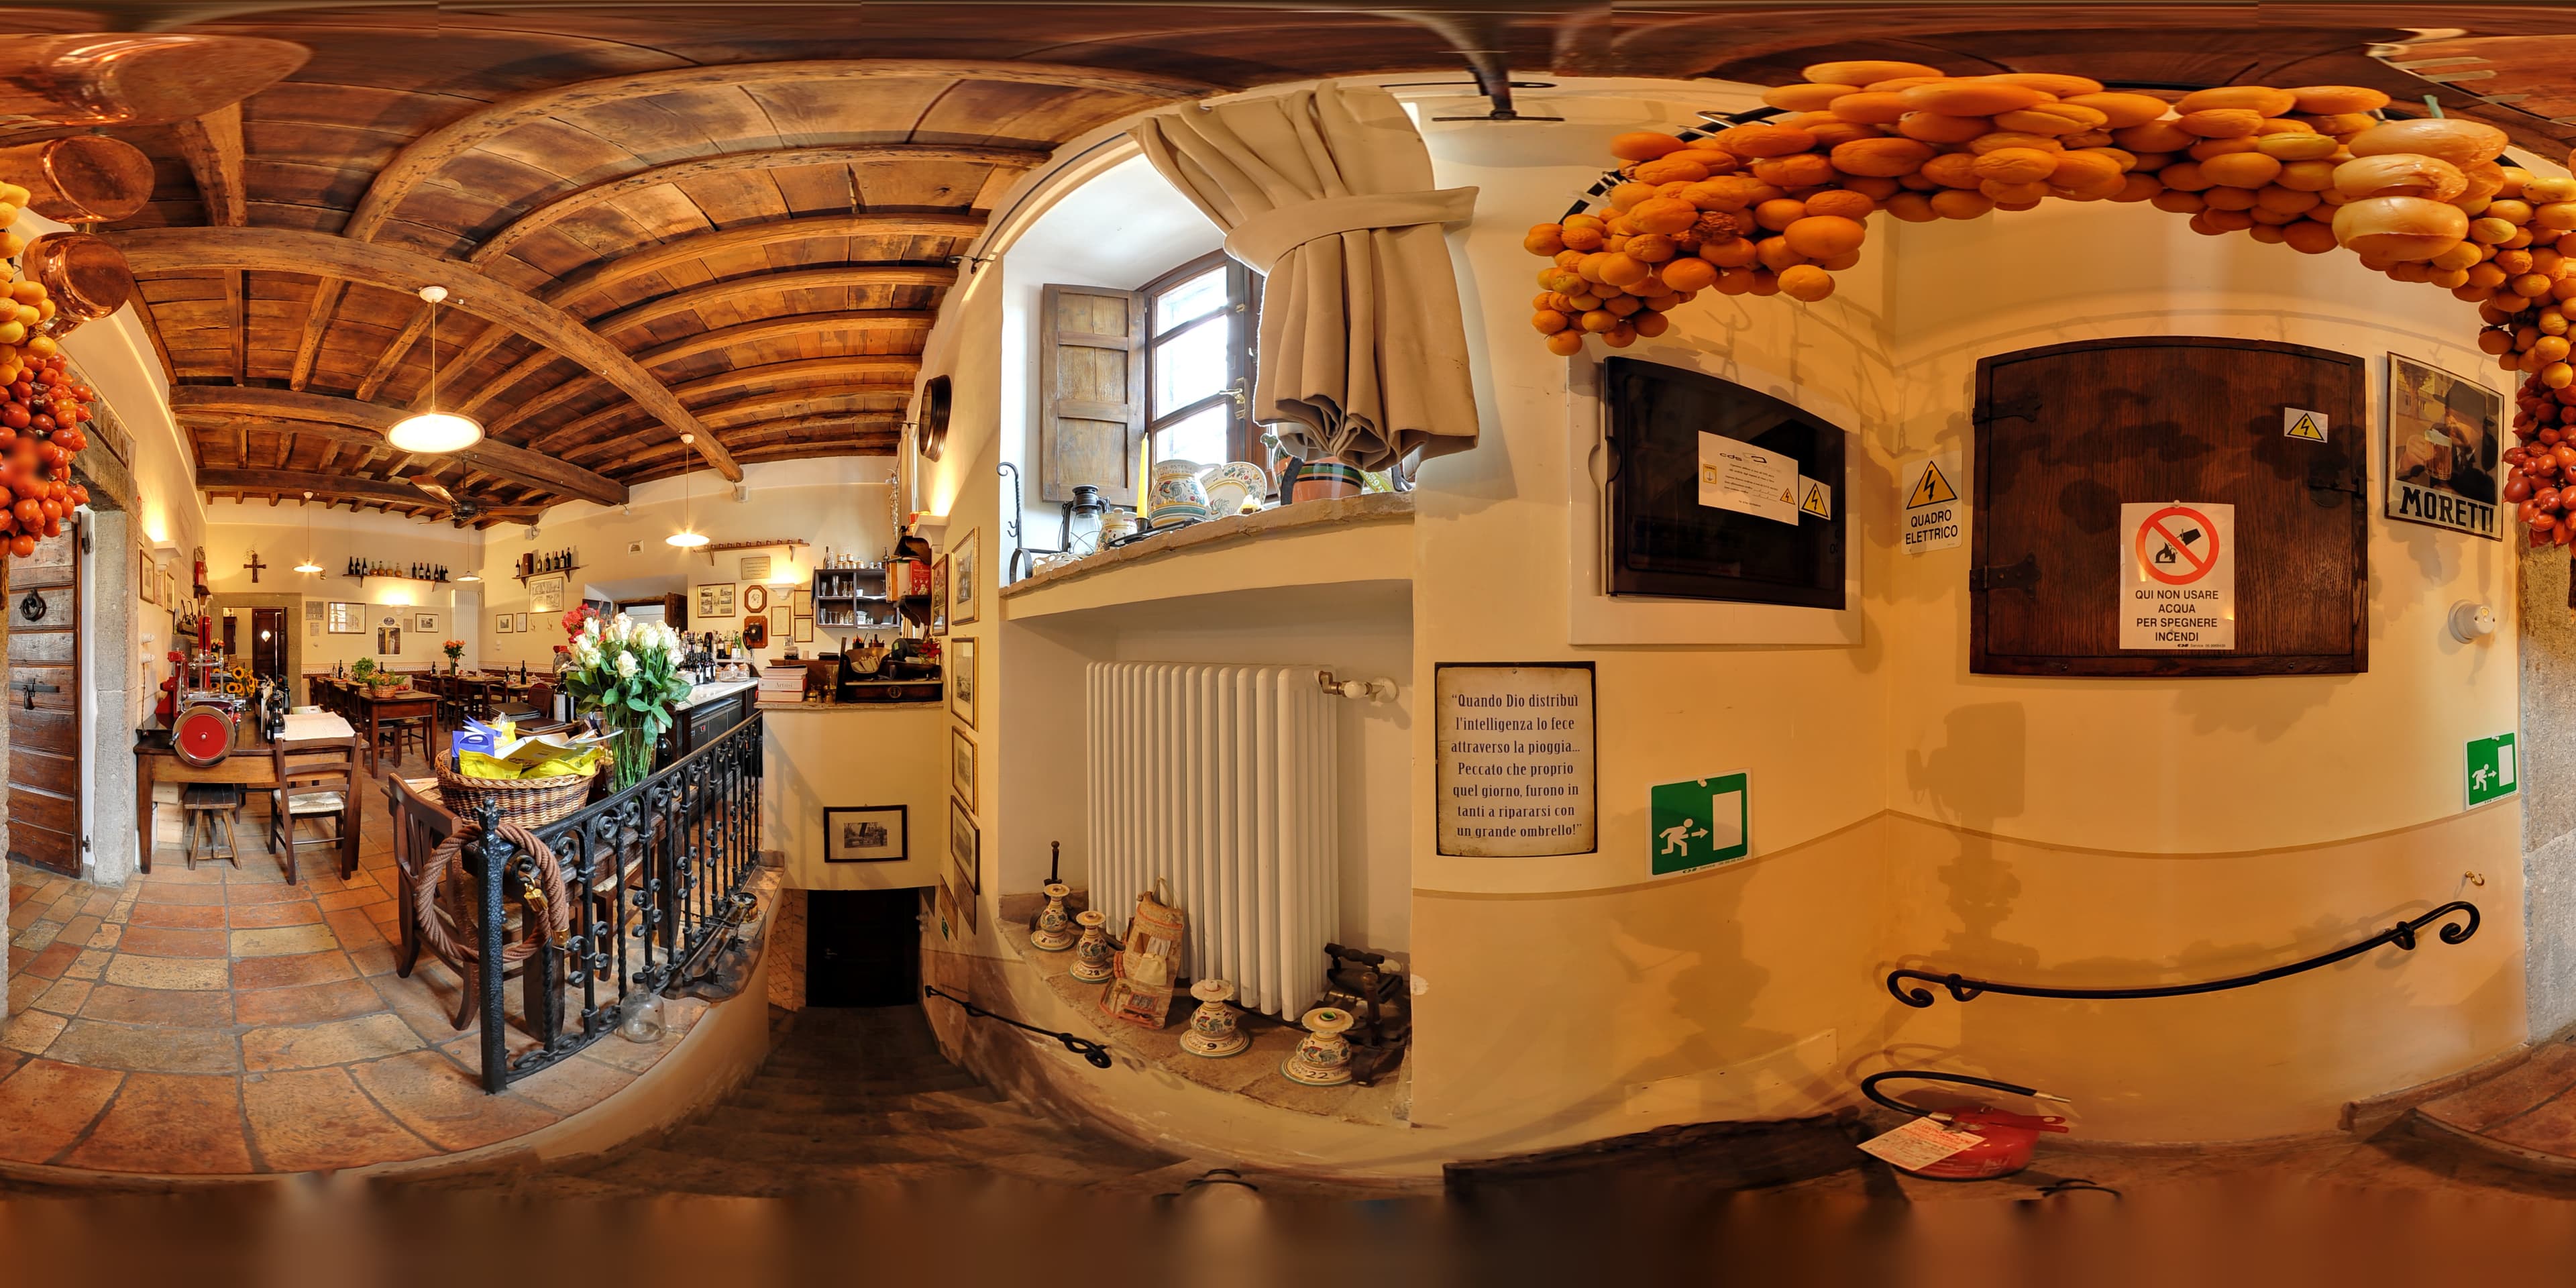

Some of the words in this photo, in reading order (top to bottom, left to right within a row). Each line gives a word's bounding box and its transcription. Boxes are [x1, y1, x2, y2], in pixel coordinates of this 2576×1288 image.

[2399, 486, 2493, 533] MORETTI
[1911, 509, 1951, 528] QUADRO
[1905, 525, 1958, 545] ELETTRICO
[2135, 590, 2153, 599] QUI
[2157, 590, 2180, 599] NON
[2184, 590, 2219, 599] USARE
[2158, 603, 2196, 613] ACQUA
[2137, 618, 2157, 627] PER
[2160, 618, 2218, 627] SPEGNERE
[2155, 632, 2199, 641] INCENDI
[1507, 694, 1525, 707] Dio
[1529, 694, 1578, 707] distribuì
[1456, 717, 1533, 732] l'intelligenza
[1537, 717, 1548, 730] lo
[1551, 717, 1574, 730] fece
[1451, 741, 1509, 753] attraverso
[1514, 741, 1524, 753] la
[1529, 740, 1580, 755] pioggia...
[1458, 762, 1503, 775] Peccato
[1507, 763, 1526, 775] che
[1530, 762, 1573, 777] proprio
[1453, 784, 1477, 798] quel
[1482, 785, 1522, 798] giorno,
[1526, 784, 1564, 796] furono
[1568, 784, 1578, 795] in
[1458, 805, 1485, 817] tanti
[1489, 808, 1495, 817] a
[1499, 805, 1550, 819] ripararsi
[1555, 806, 1574, 816] con
[1457, 827, 1471, 836] un
[1475, 826, 1516, 838] grande
[1207, 1042, 1218, 1051] 9
